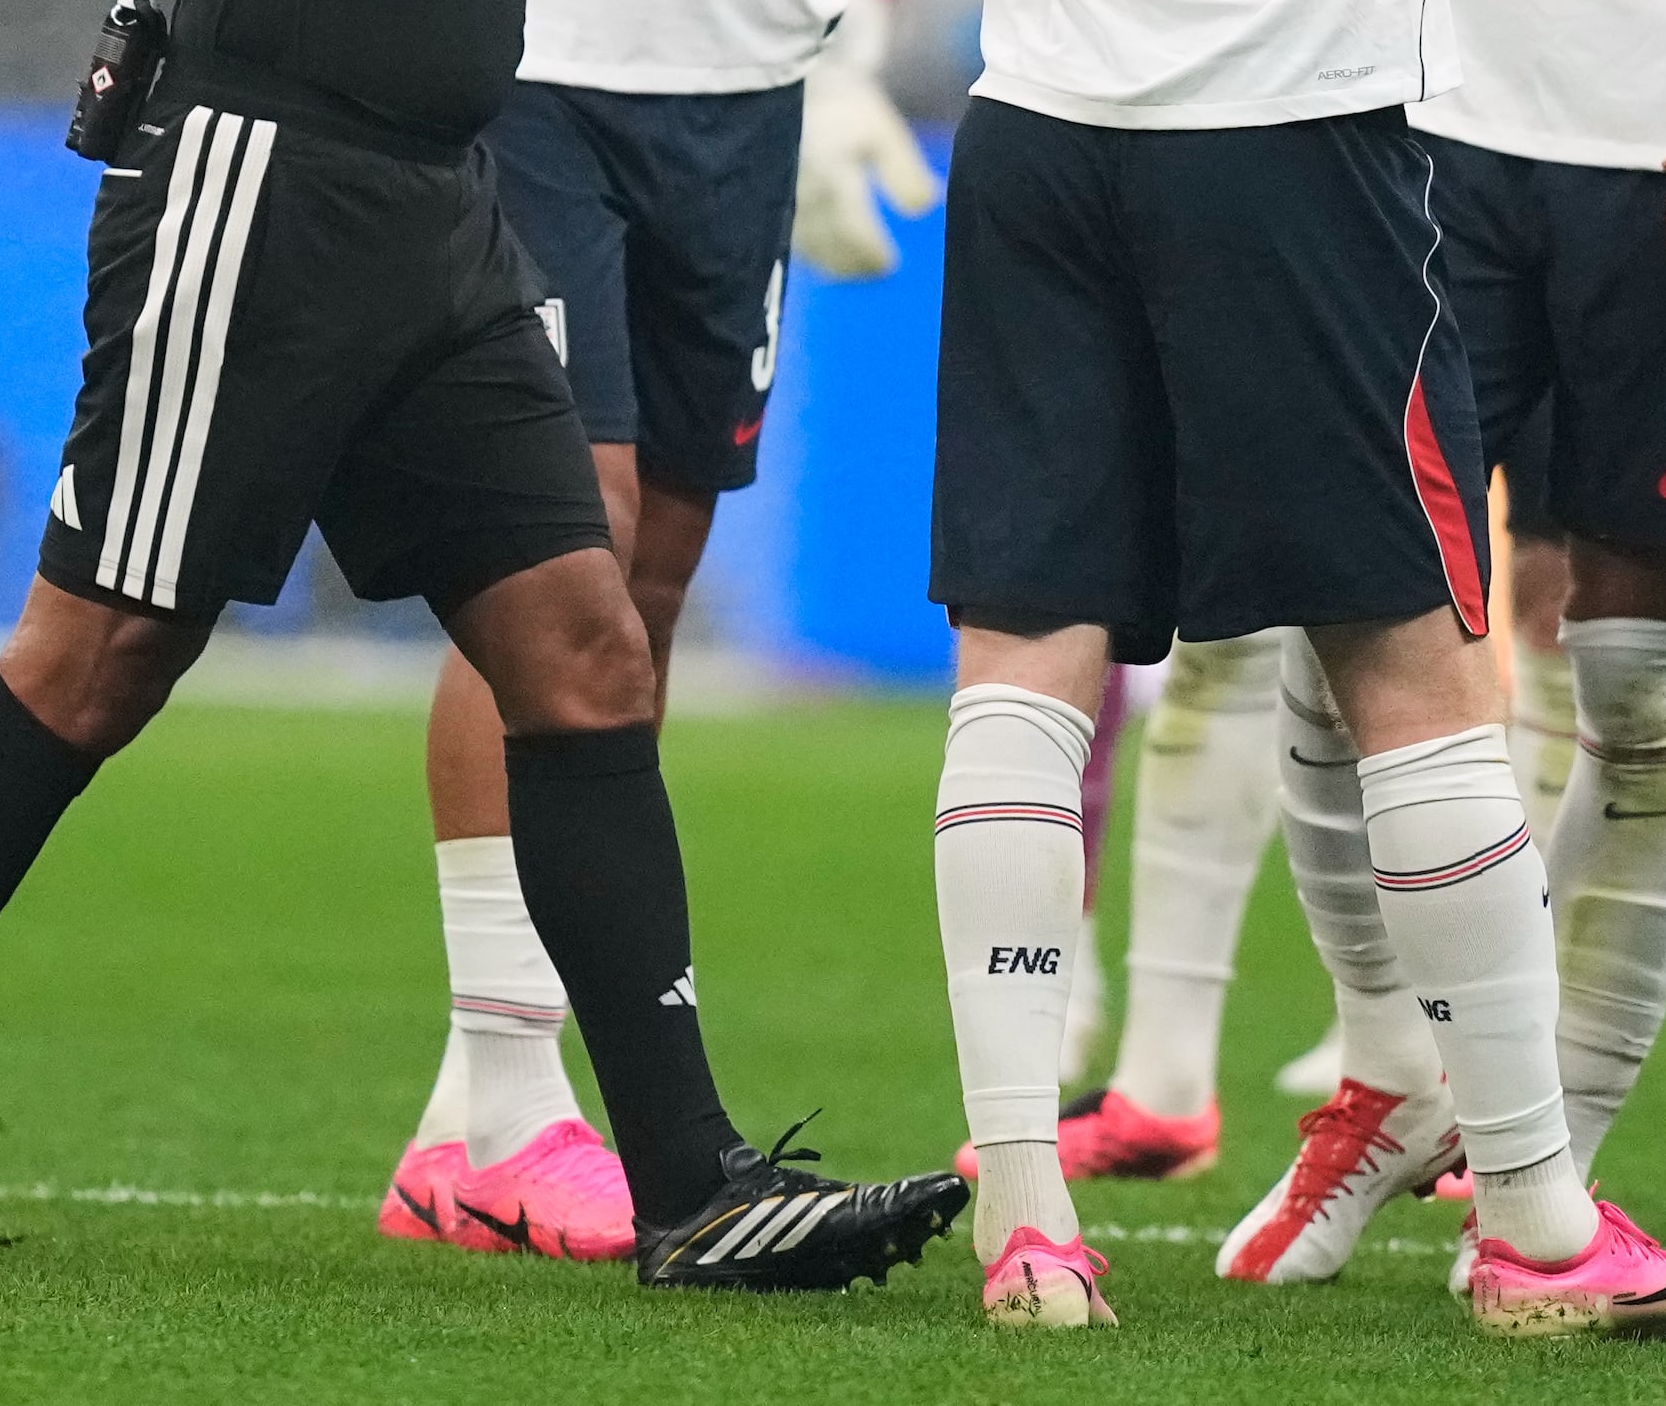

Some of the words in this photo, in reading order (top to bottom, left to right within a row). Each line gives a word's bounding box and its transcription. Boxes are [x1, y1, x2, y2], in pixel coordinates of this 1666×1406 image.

[1317, 65, 1375, 81] AERO-FIT
[988, 946, 1061, 975] ENG
[1416, 995, 1453, 1022] NG
